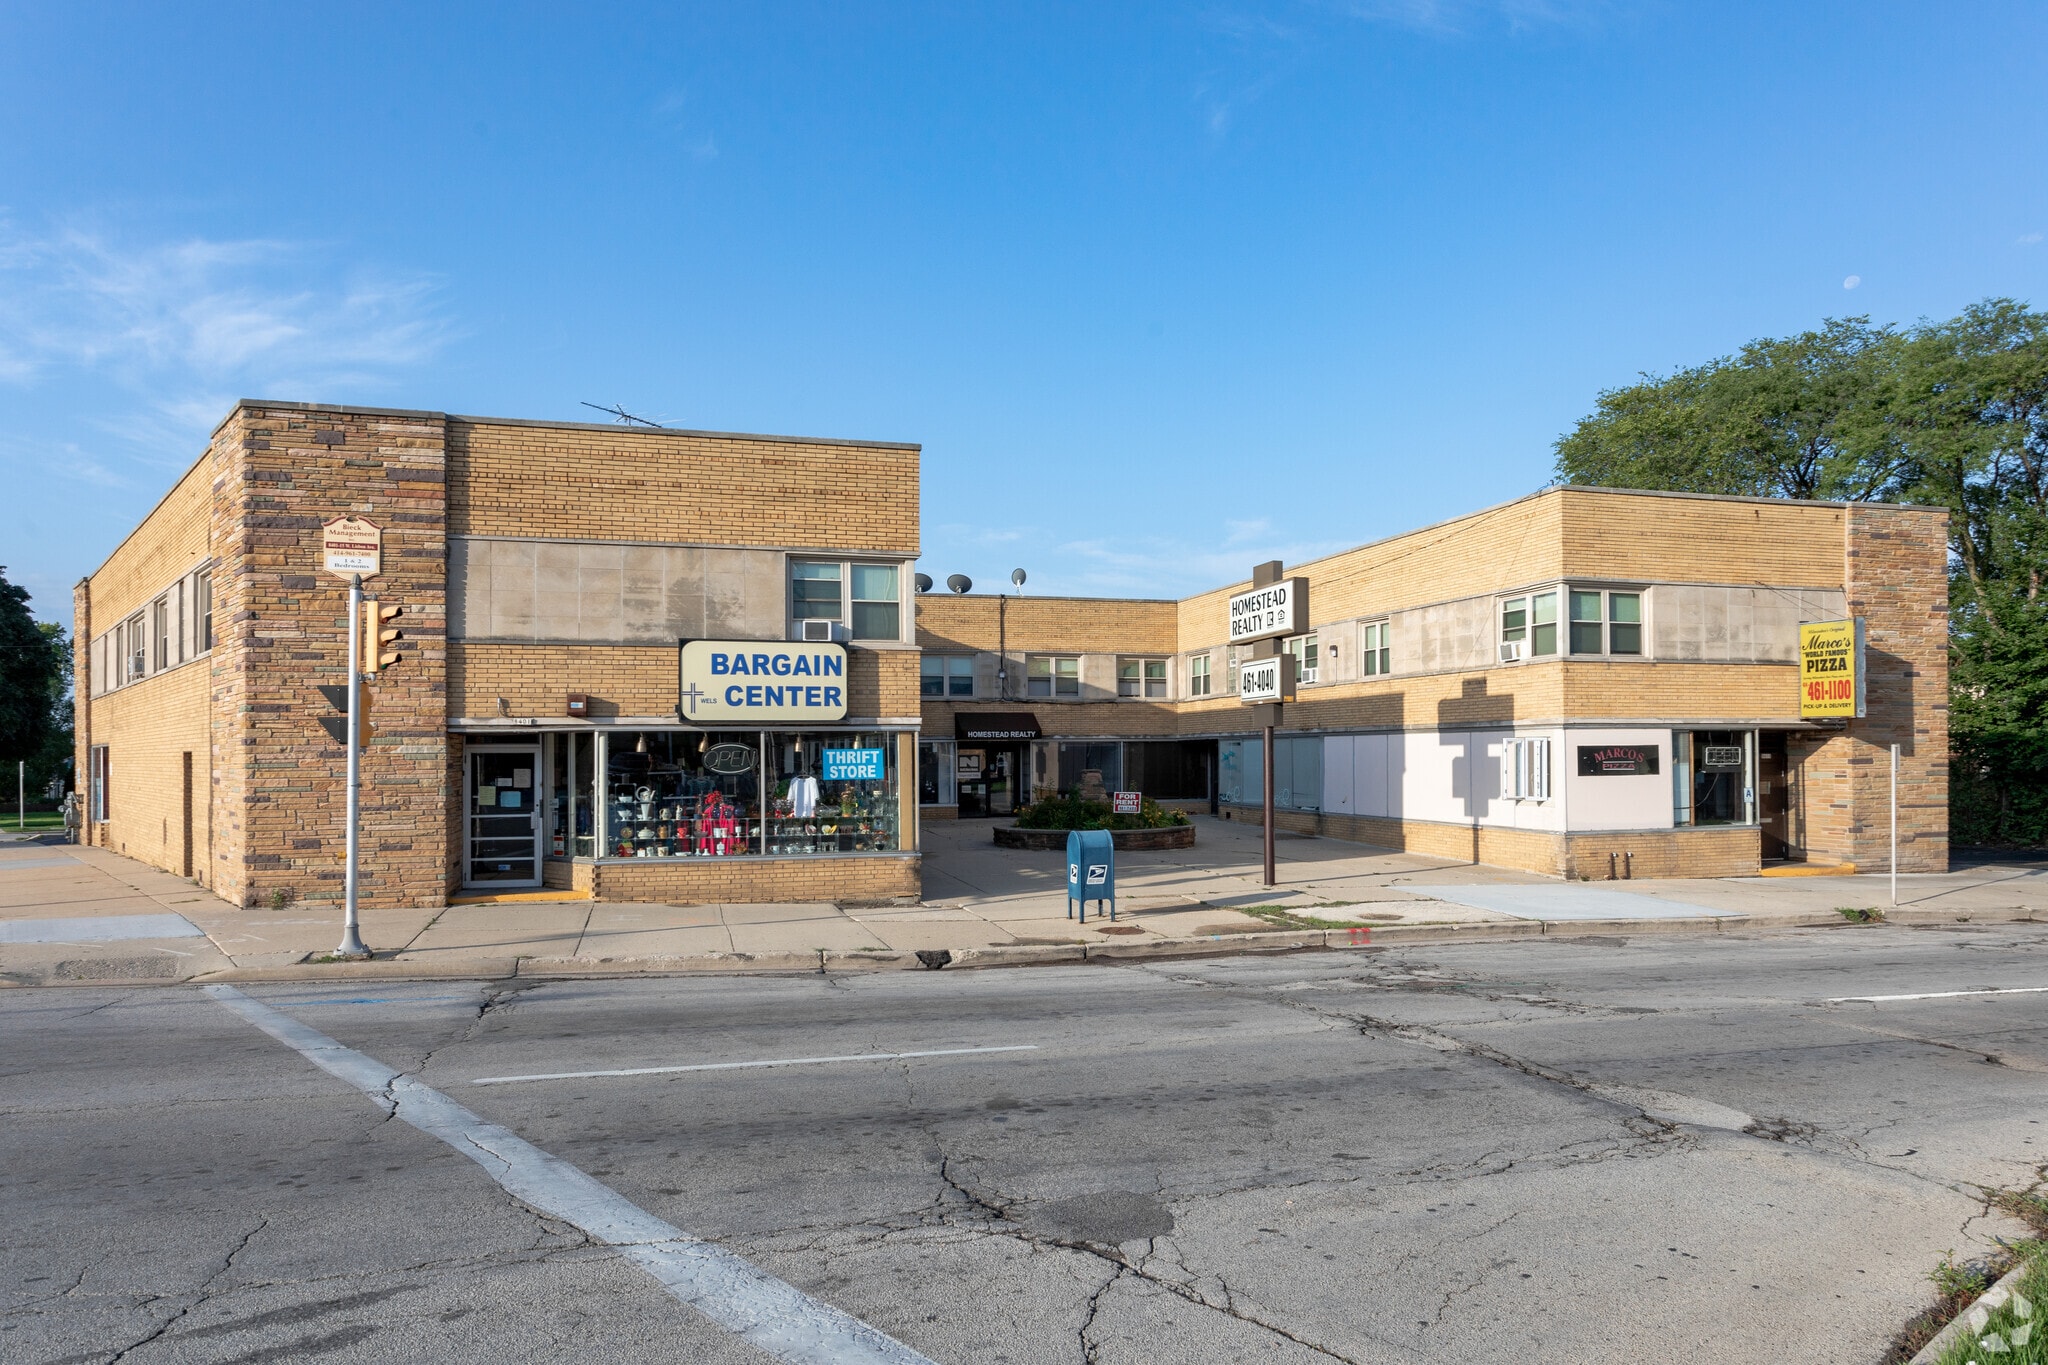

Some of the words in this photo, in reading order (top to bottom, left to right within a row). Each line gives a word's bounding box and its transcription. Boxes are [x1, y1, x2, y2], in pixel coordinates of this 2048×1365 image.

[1232, 588, 1286, 617] HOMESTEAD
[1232, 613, 1263, 636] REALTY
[1802, 635, 1851, 651] Marco's
[711, 653, 842, 677] BARGAIN
[1806, 657, 1848, 673] PIZZA
[700, 697, 718, 705] WELS
[725, 685, 842, 707] CENTER
[1010, 730, 1036, 738] REALTY
[703, 751, 758, 769] OPEN
[826, 751, 880, 765] THRIFT
[829, 765, 876, 779] STORE
[1746, 790, 1752, 798] A
